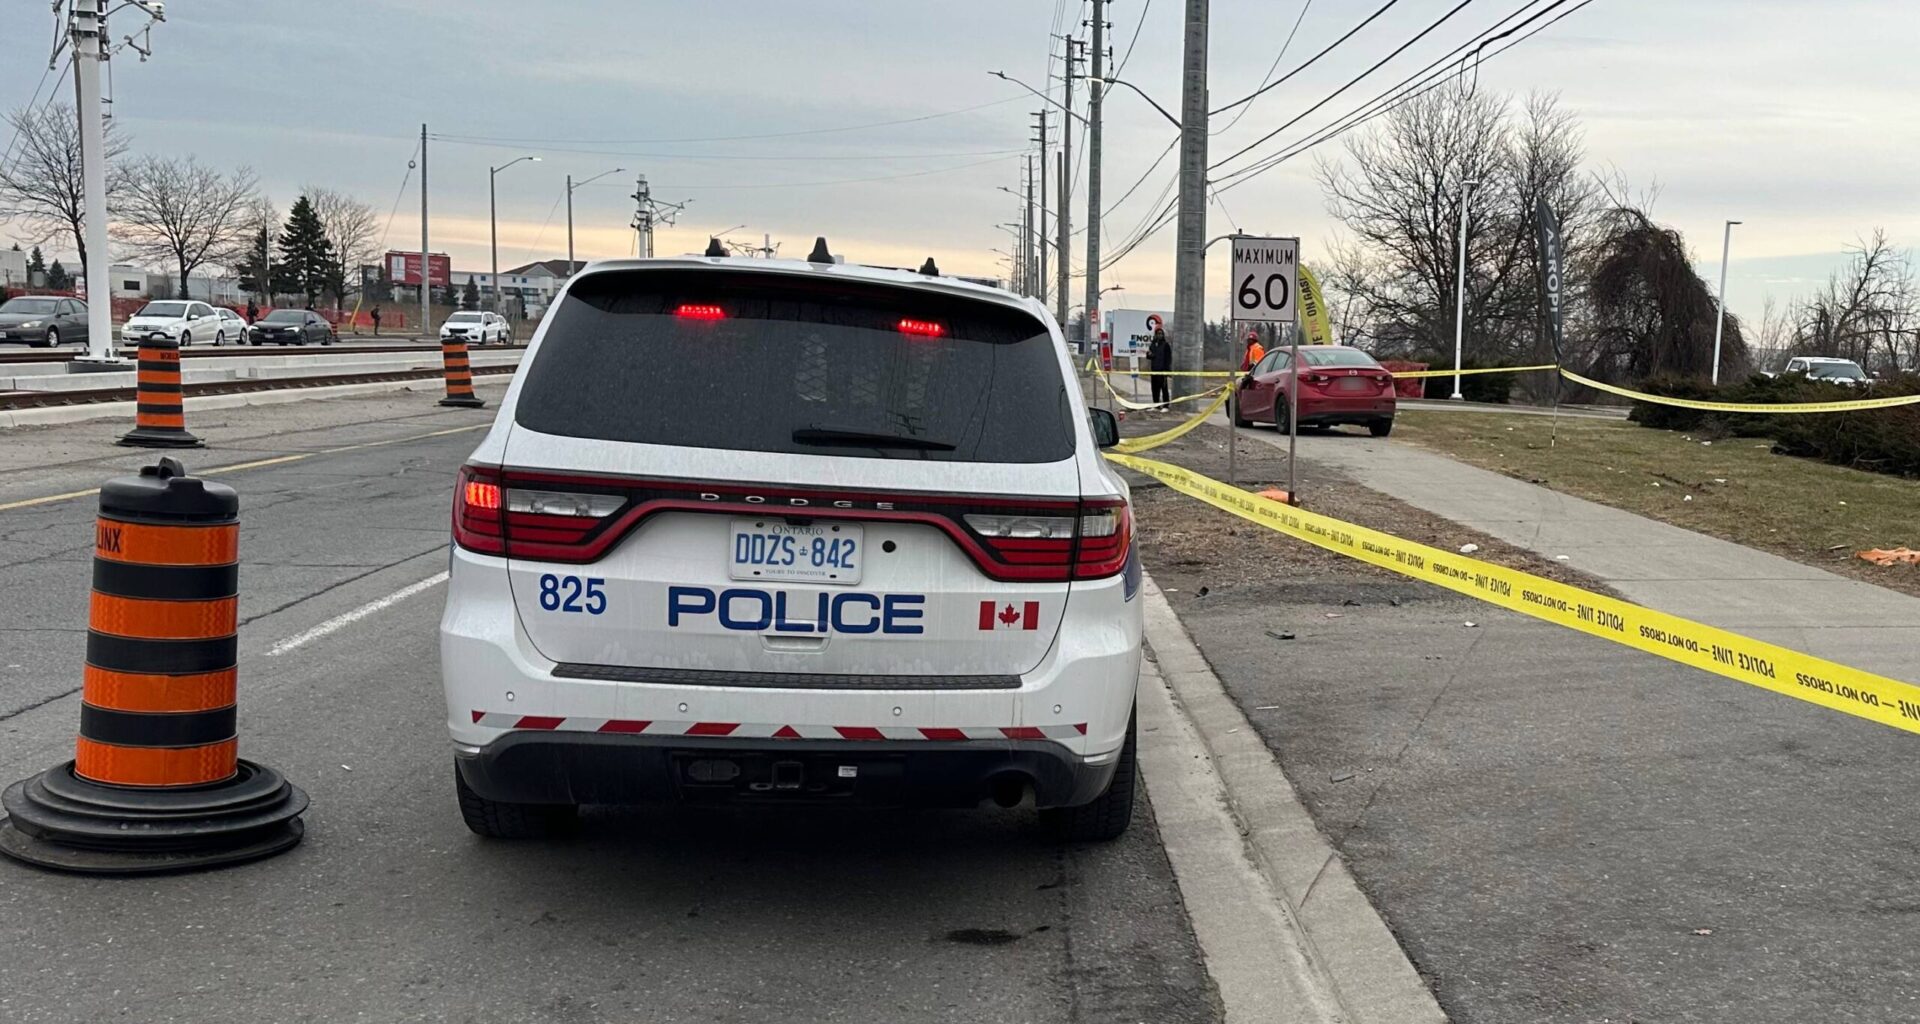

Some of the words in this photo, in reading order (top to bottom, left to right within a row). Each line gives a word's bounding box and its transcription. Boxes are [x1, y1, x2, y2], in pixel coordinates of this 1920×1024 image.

[1235, 248, 1293, 265] MAXIMUM
[1238, 273, 1289, 310] 60
[1305, 301, 1317, 317] ON
[700, 492, 894, 510] DODGE
[735, 533, 795, 566] DDZS
[811, 537, 856, 568] 842
[539, 573, 607, 615] 825
[1490, 577, 1511, 597] POLICE
[1522, 589, 1543, 605] CROSS
[1544, 595, 1556, 609] NOT
[1557, 599, 1567, 612] DO
[668, 585, 925, 634] POLICE
[1577, 603, 1594, 623] LINE
[1597, 609, 1624, 632] POLICE
[1639, 625, 1666, 643] CROSS
[1668, 633, 1684, 648] NOT
[1685, 639, 1698, 653] DO
[1712, 644, 1734, 666] LINE
[1738, 652, 1776, 679] POLICE
[1796, 672, 1834, 693] CROSS
[1836, 684, 1859, 701] NOT
[1861, 691, 1879, 707] DO
